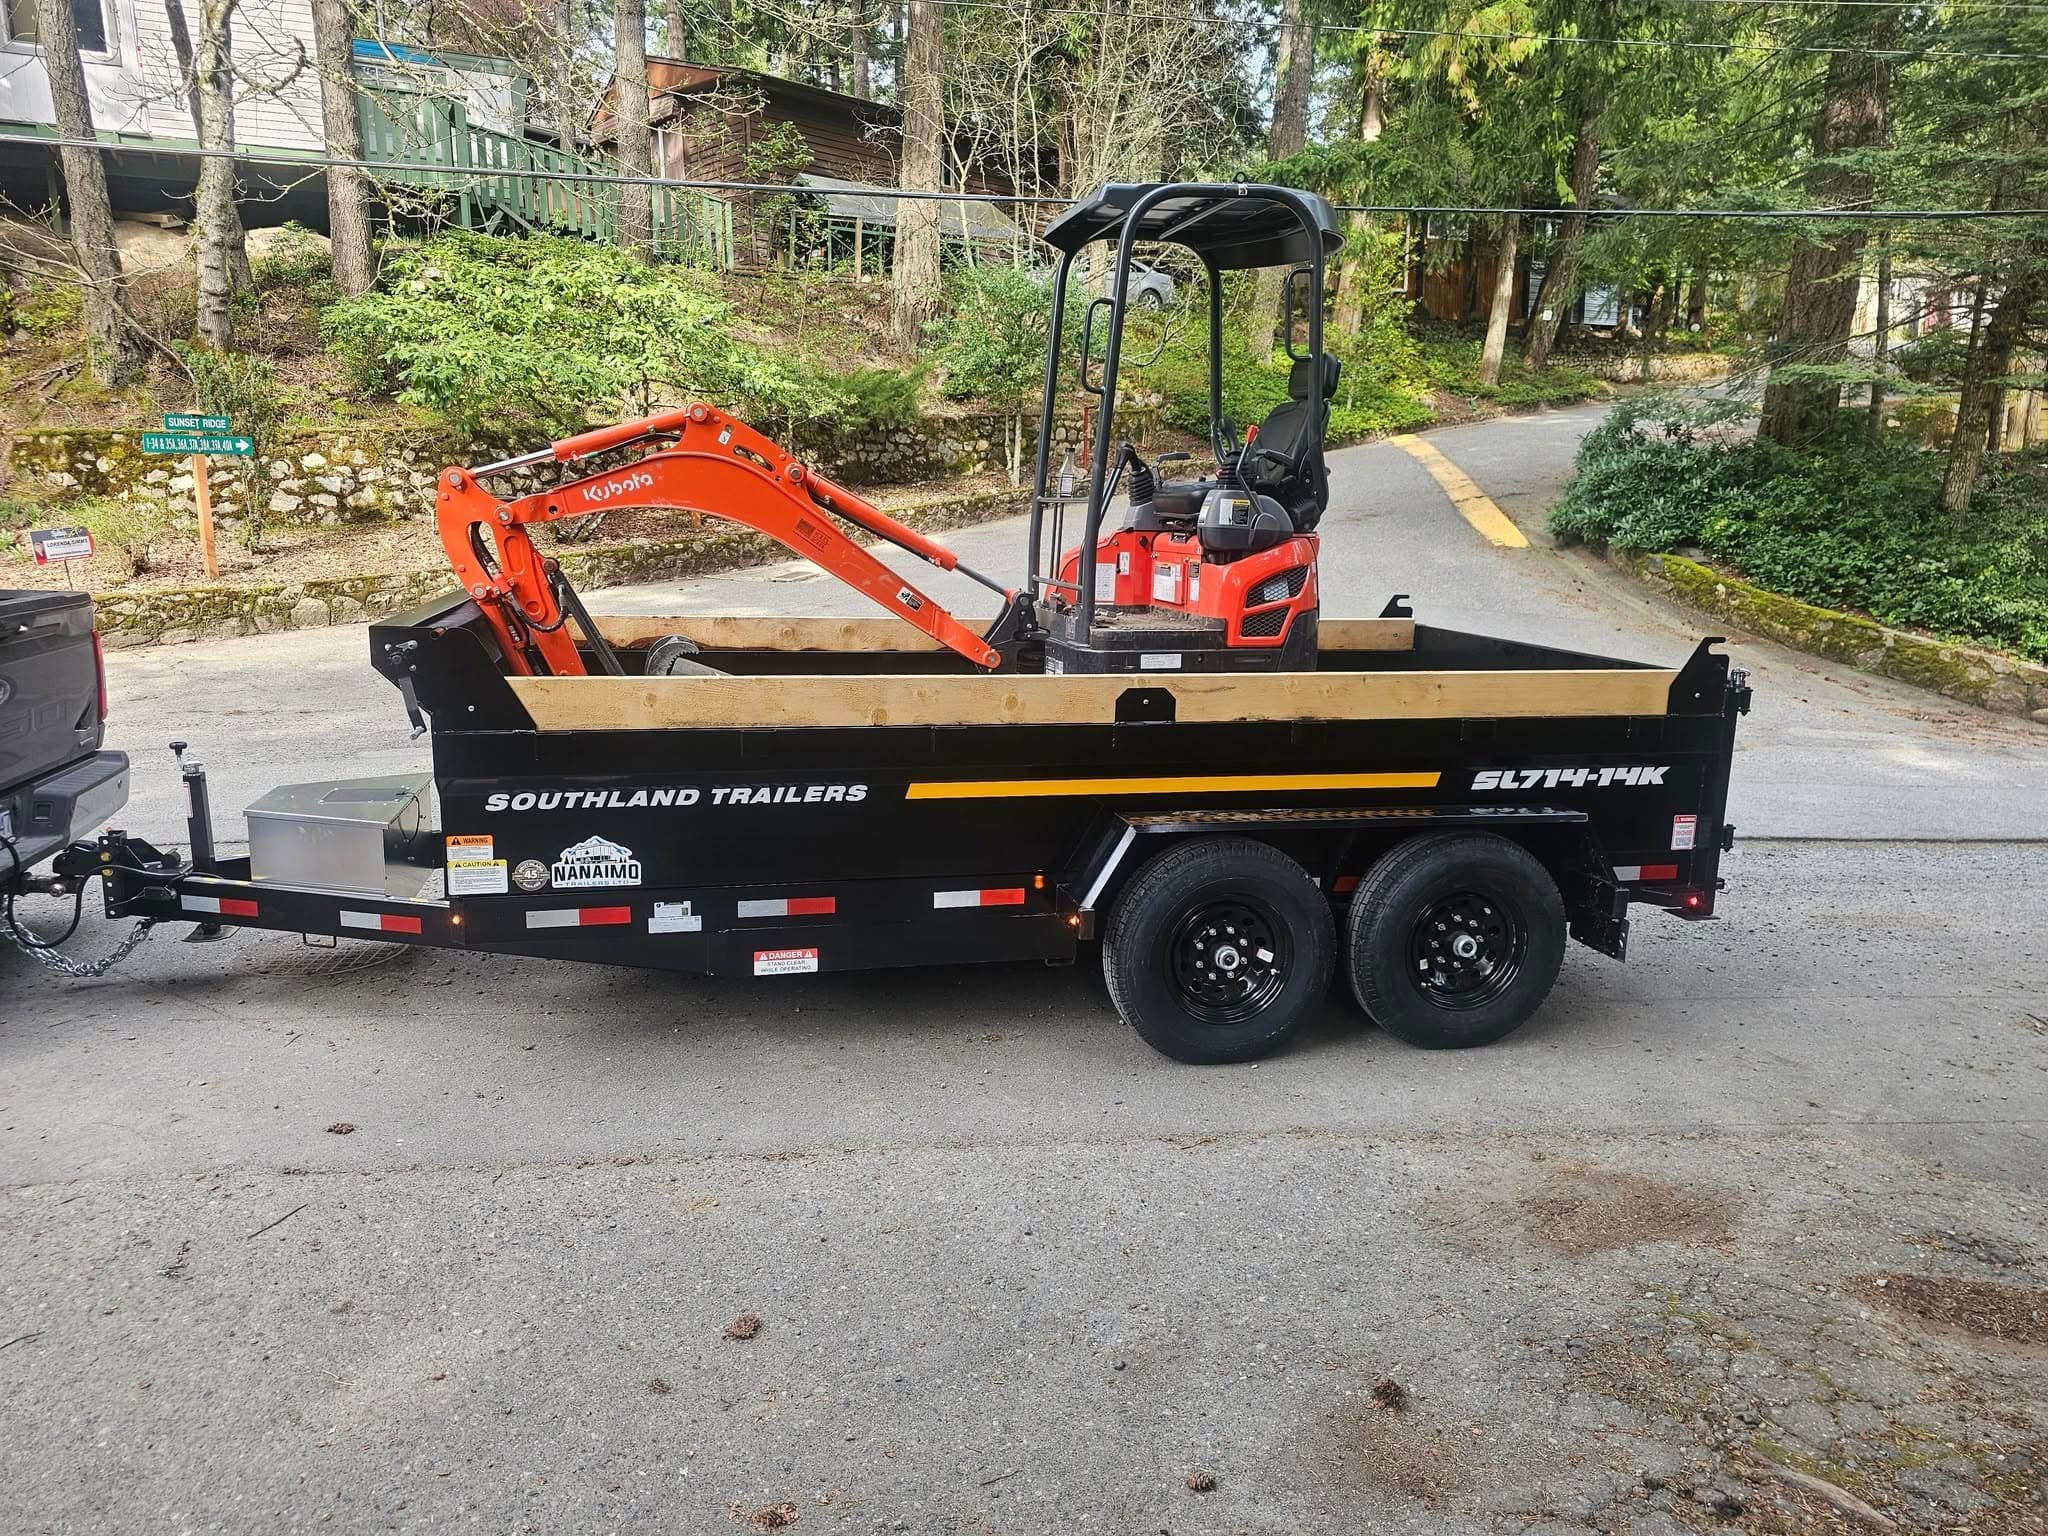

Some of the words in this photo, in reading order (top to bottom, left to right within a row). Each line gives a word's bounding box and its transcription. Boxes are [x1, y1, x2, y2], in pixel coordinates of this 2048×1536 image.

[168, 417, 200, 429] SUNSET
[202, 419, 226, 429] RIDGE
[160, 438, 166, 450] &
[582, 473, 654, 501] Kubota
[1471, 766, 1670, 790] SL714-14K
[485, 789, 700, 812] SOUTHLAND
[711, 784, 868, 805] TRAILERS
[524, 870, 538, 879] 45
[554, 864, 639, 882] NANAIMO
[769, 951, 803, 960] DANGER
